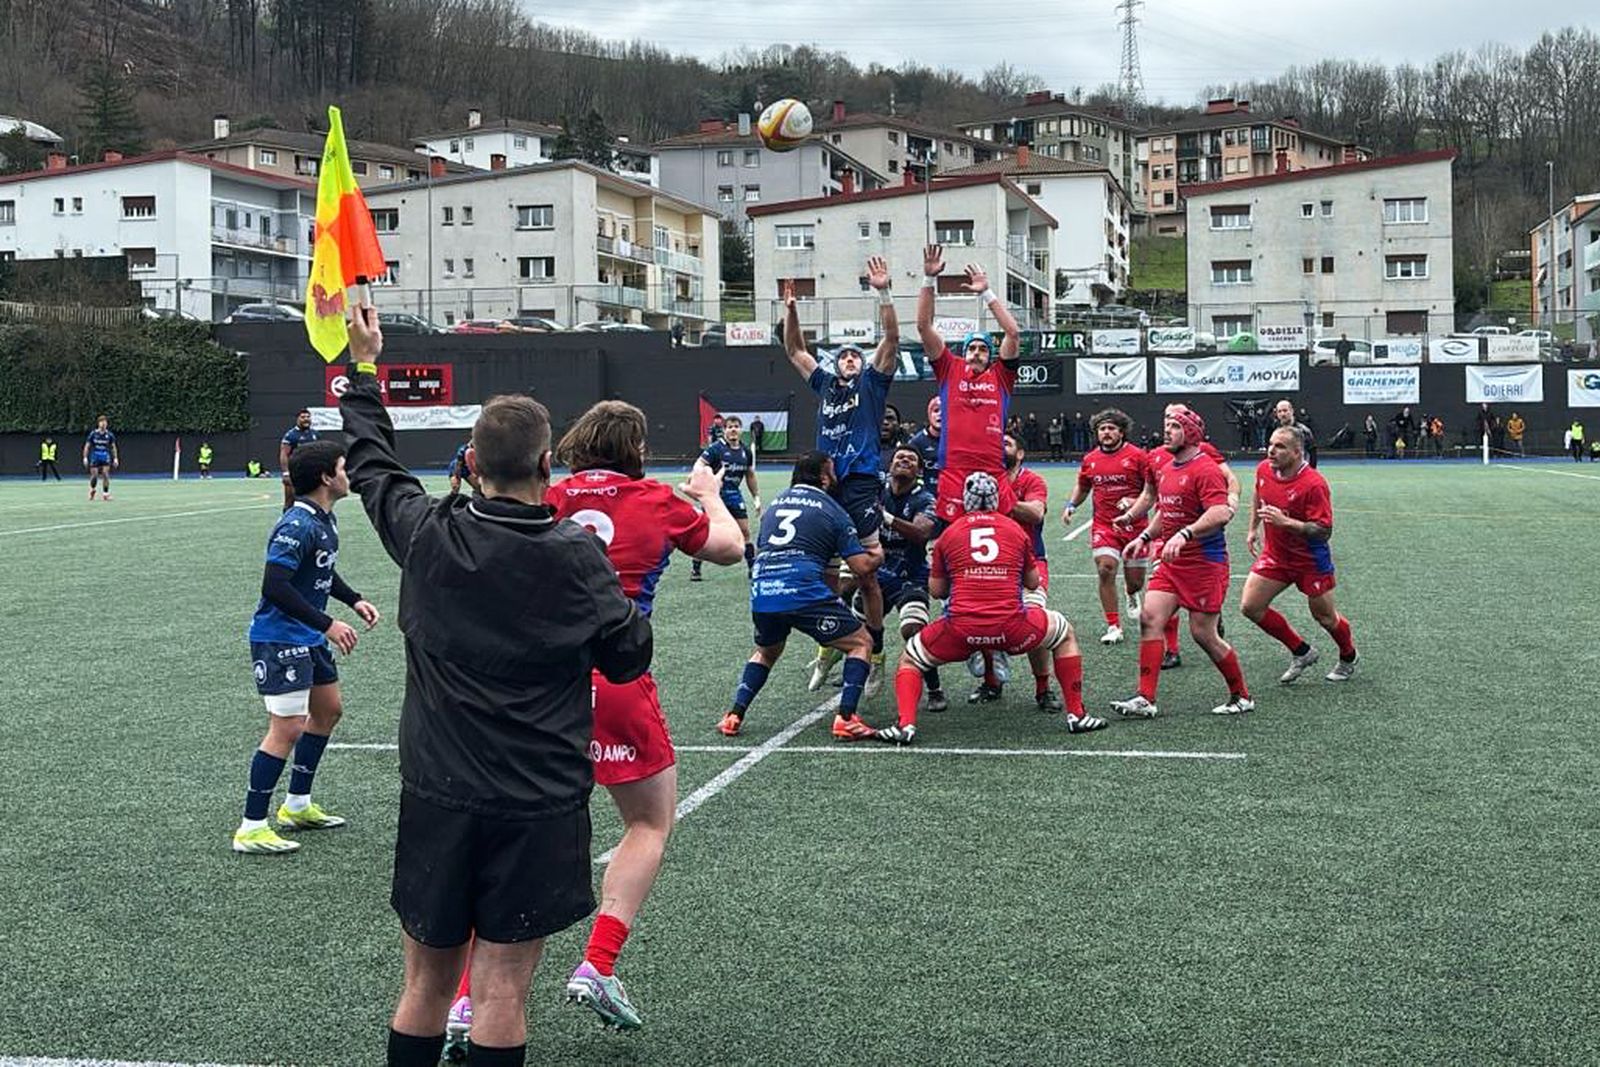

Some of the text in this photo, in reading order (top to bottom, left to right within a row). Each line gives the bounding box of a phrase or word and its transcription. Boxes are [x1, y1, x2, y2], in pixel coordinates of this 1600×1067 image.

[1041, 332, 1086, 349] IZIAR
[1247, 370, 1298, 382] MOYUA
[1347, 377, 1416, 387] GARMENDIA
[1483, 385, 1524, 396] GOIERRI
[767, 508, 803, 546] 3
[970, 527, 1000, 562] 5
[602, 744, 637, 763] AMPO
